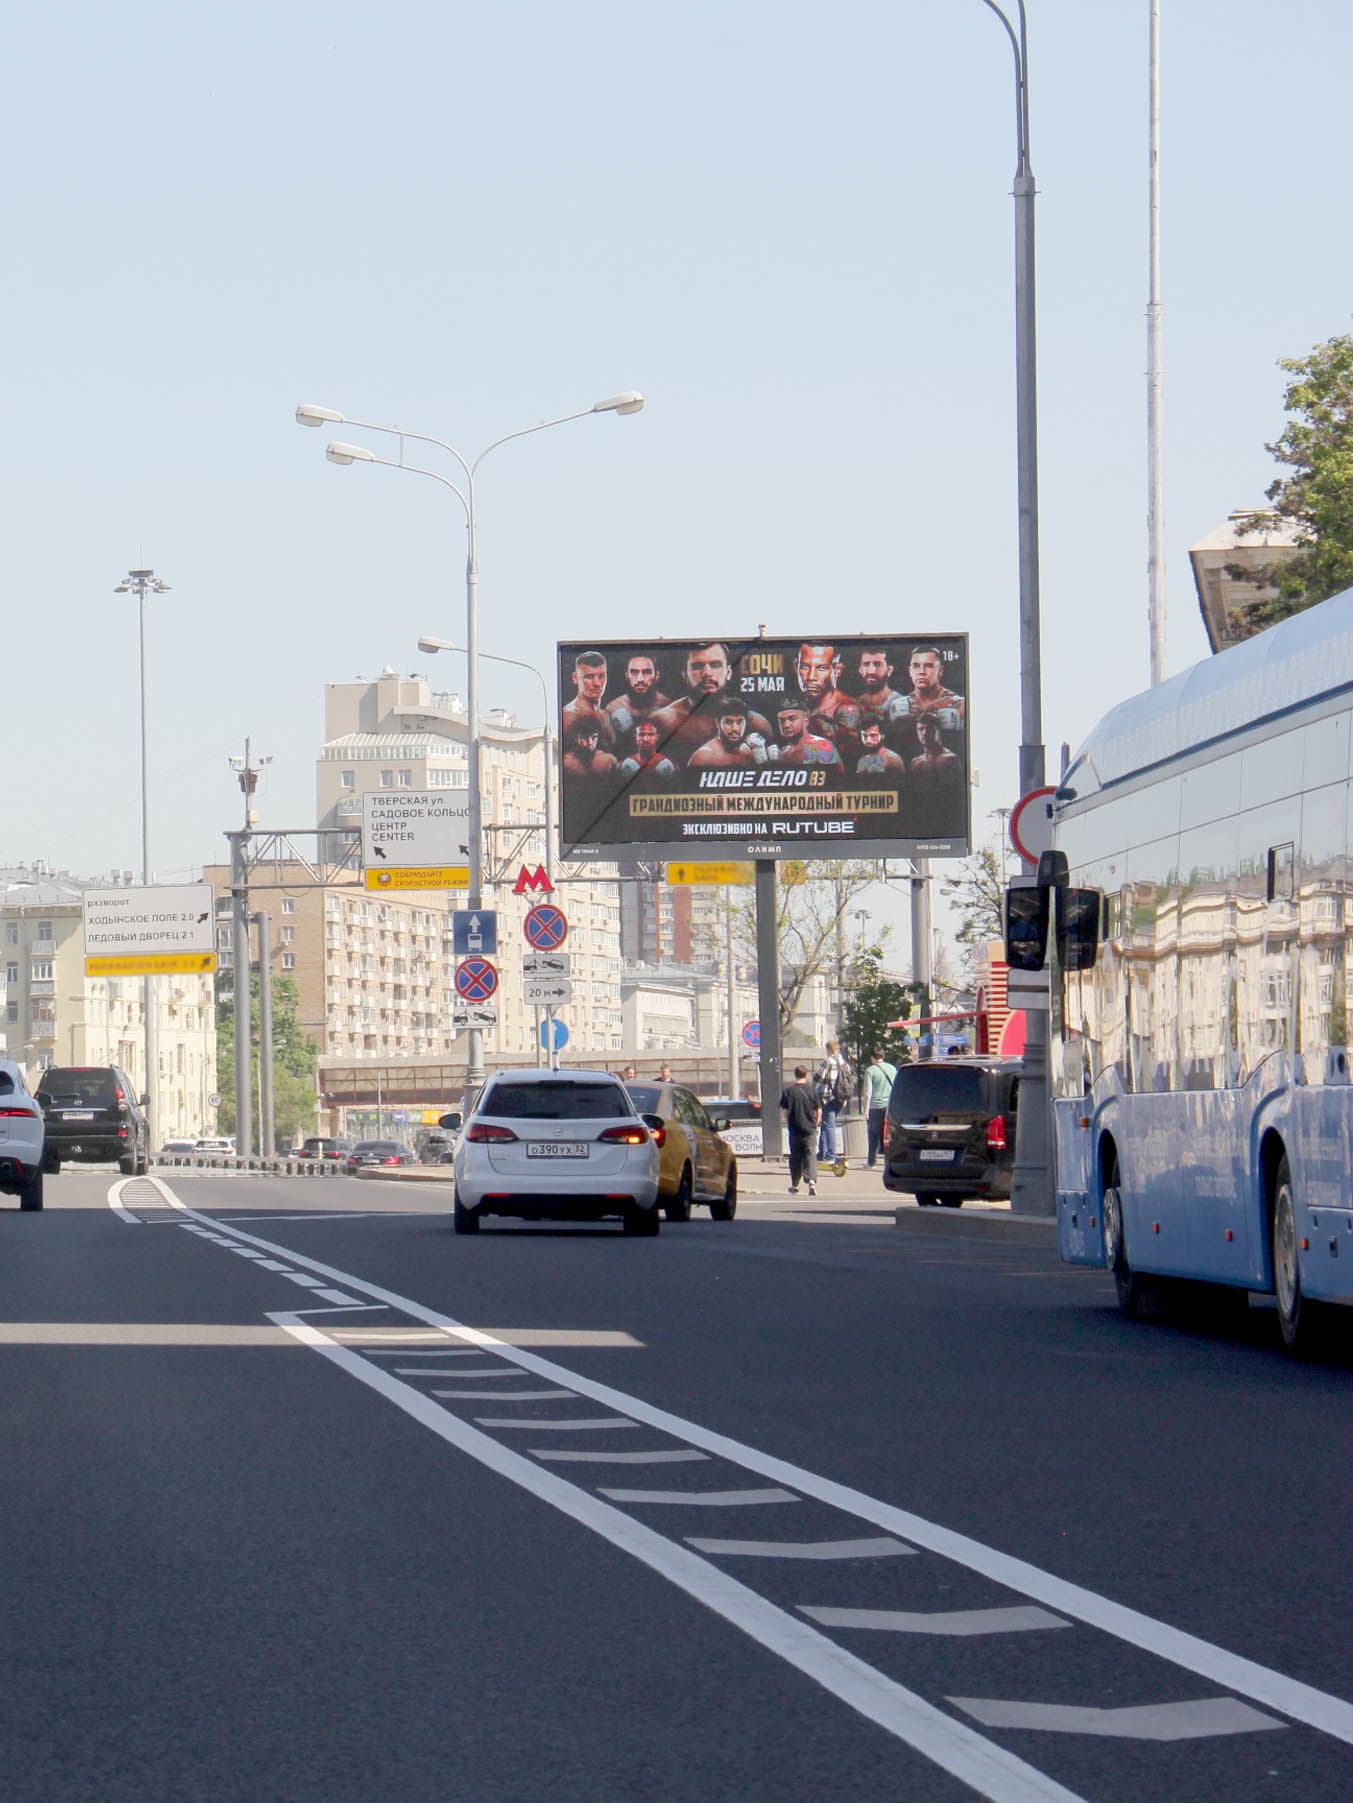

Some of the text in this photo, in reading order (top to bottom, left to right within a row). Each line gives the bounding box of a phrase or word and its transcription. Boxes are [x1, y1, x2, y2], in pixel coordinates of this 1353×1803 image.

[943, 650, 959, 661] 18+
[740, 654, 784, 674] СОЧИ
[741, 677, 785, 692] 25 МАЯ
[699, 770, 826, 788] НАШЕ ДЕЛО 83
[372, 796, 428, 806] ТВЕРСКАЯ
[633, 793, 894, 813] ГРАНДИОЗНЫЙ МЕЖДУНАРОДНЫЙ ТУРНИР
[371, 809, 424, 819] САДОВОЕ
[372, 822, 407, 832] ЦЕНТР
[682, 821, 855, 836] ЭКСКЛЮЗИВНО НА RUTUBE
[372, 832, 415, 842] CENTER
[747, 846, 781, 854] ОЛИМП
[87, 899, 129, 908] разворот
[88, 915, 149, 925] ХОДЫНСКОЕ
[152, 914, 178, 923] ПОЛЕ
[139, 932, 179, 942] ДВОРЕЦ
[529, 988, 541, 997] 20
[735, 1143, 762, 1152] ВОЛН
